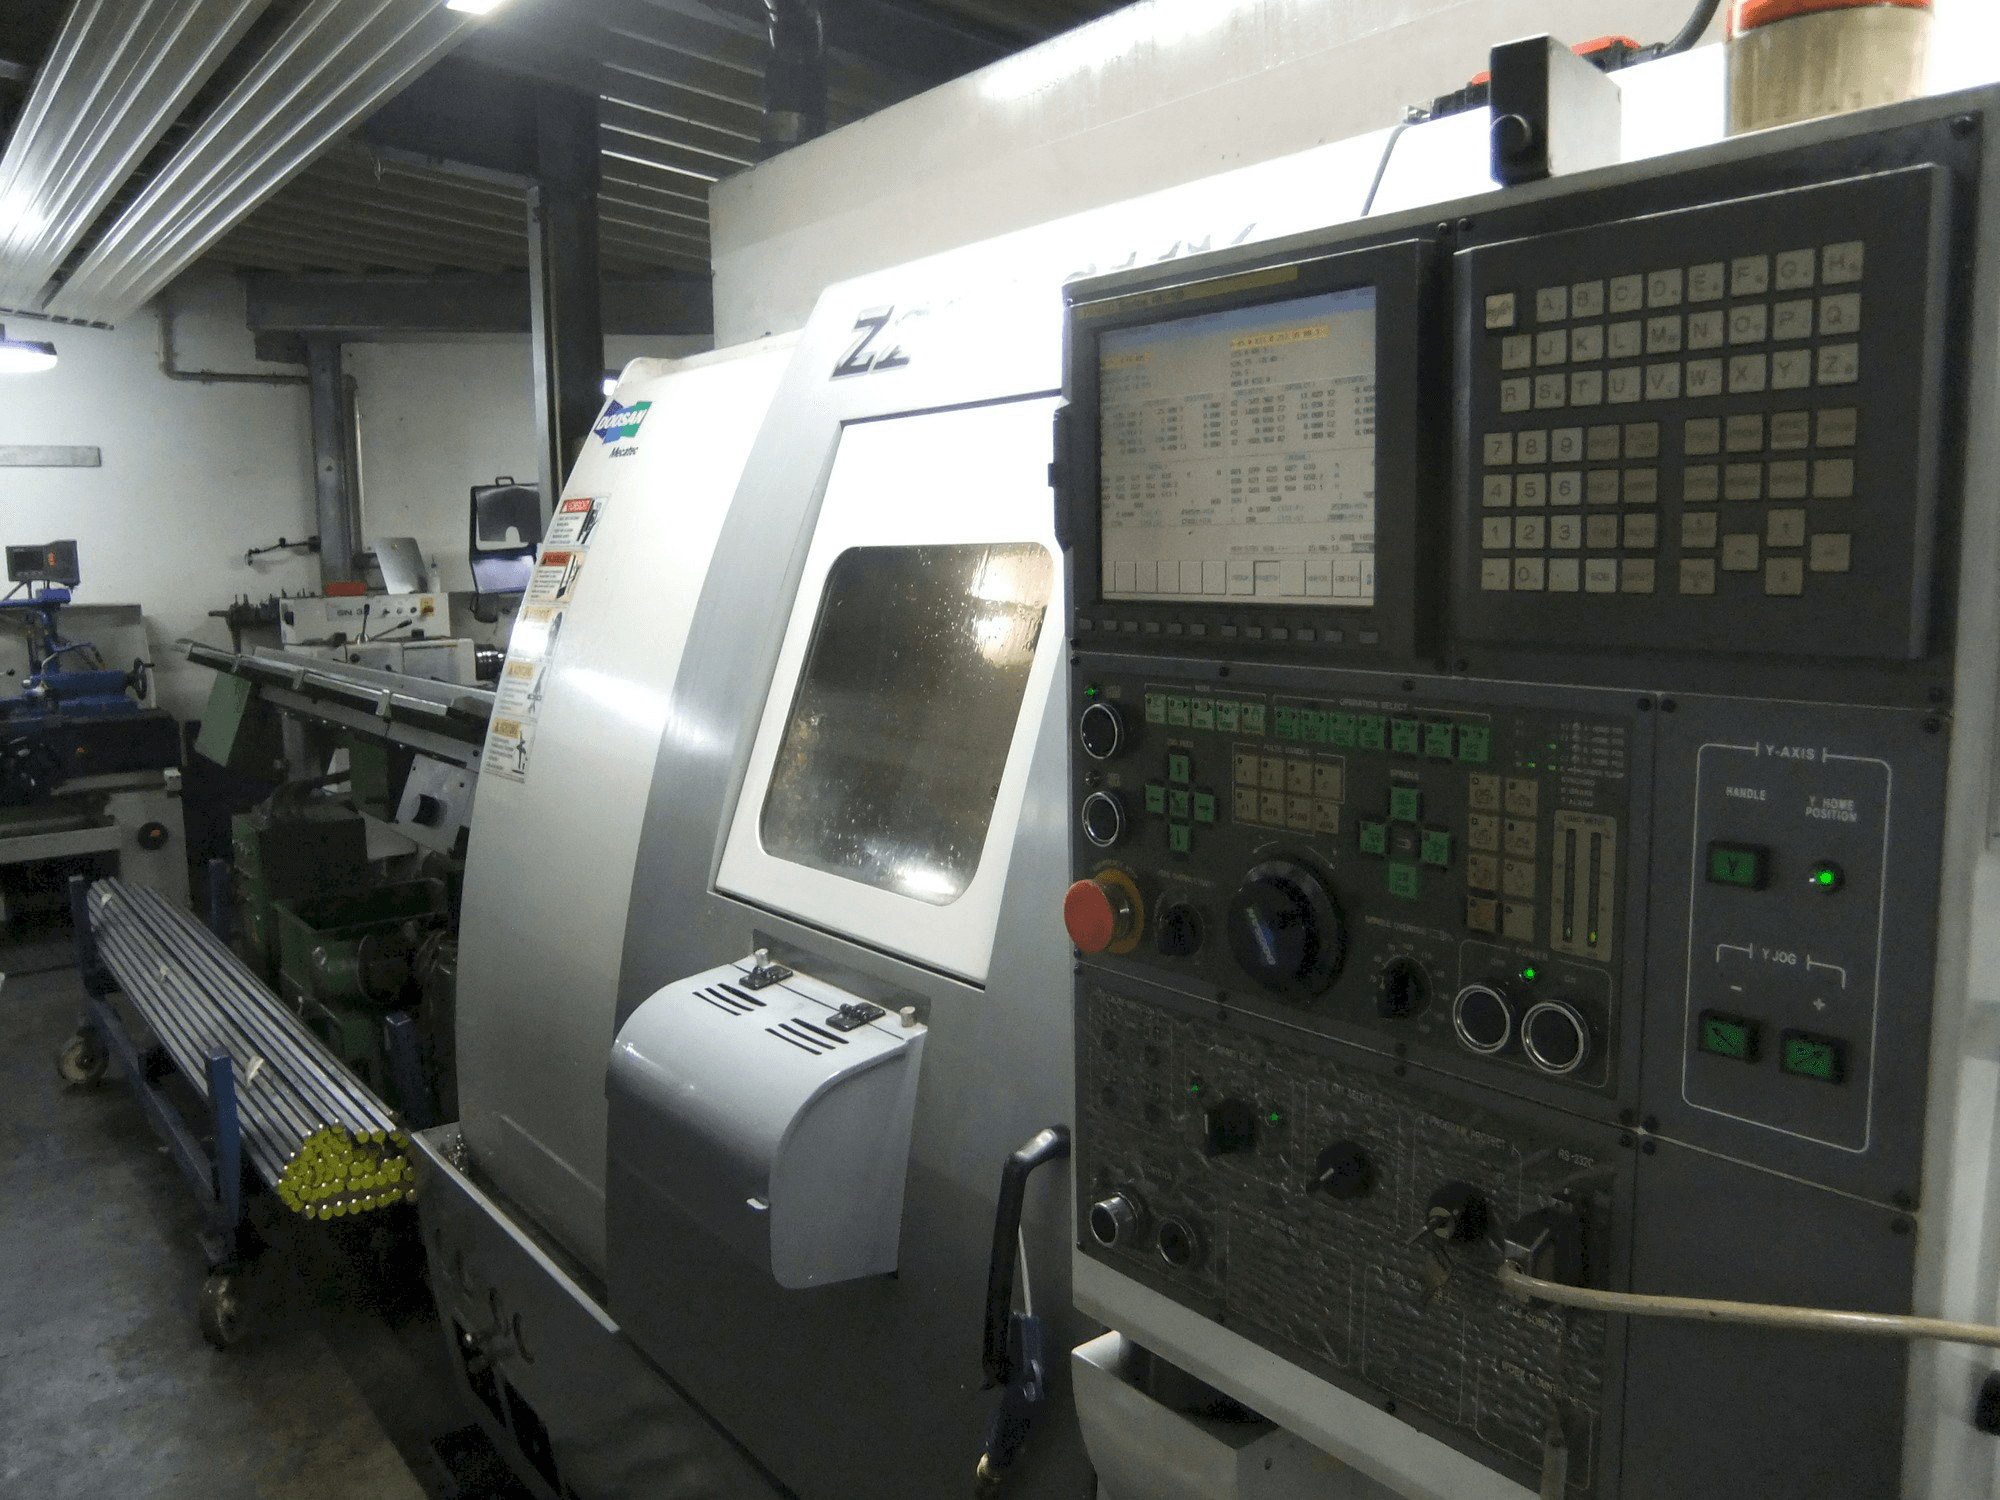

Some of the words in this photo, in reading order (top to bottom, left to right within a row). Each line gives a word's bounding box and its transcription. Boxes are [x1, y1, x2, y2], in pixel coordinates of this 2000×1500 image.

[1542, 297, 1554, 311] A
[1576, 291, 1589, 307] B
[1615, 286, 1628, 301] C
[1652, 279, 1666, 298] D
[1694, 273, 1706, 292] E
[1737, 265, 1750, 282] F
[1829, 254, 1845, 271] H
[1541, 340, 1553, 356] J
[1576, 337, 1588, 351] K
[1613, 333, 1625, 349] L
[1651, 326, 1666, 343] M
[1694, 323, 1707, 338] N
[1734, 315, 1751, 333] O
[1826, 304, 1842, 325] Q
[1504, 386, 1517, 402] R
[1538, 384, 1551, 399] S
[1576, 379, 1588, 396] T
[1613, 376, 1625, 394] U
[1651, 373, 1664, 390] V
[1690, 369, 1707, 385] W
[1735, 365, 1748, 382] X
[1778, 361, 1792, 378] Y
[1824, 356, 1839, 373] Z
[596, 409, 648, 431] DOOSAN
[1491, 441, 1503, 456] 7
[1525, 438, 1538, 455] 8
[1560, 437, 1573, 454] 9
[1490, 483, 1503, 498] 4
[1525, 482, 1537, 498] 5
[1559, 480, 1571, 496] 6
[1491, 525, 1499, 540] 1
[1524, 525, 1536, 541] 2
[1558, 524, 1570, 540] 3
[1517, 566, 1530, 582] 0
[1764, 744, 1816, 760] Y-AXIS
[1726, 785, 1768, 802] HANDLE
[1823, 797, 1856, 810] HOME
[1805, 806, 1858, 823] POSITION
[1762, 948, 1772, 962] Y
[1772, 950, 1797, 965] JOG
